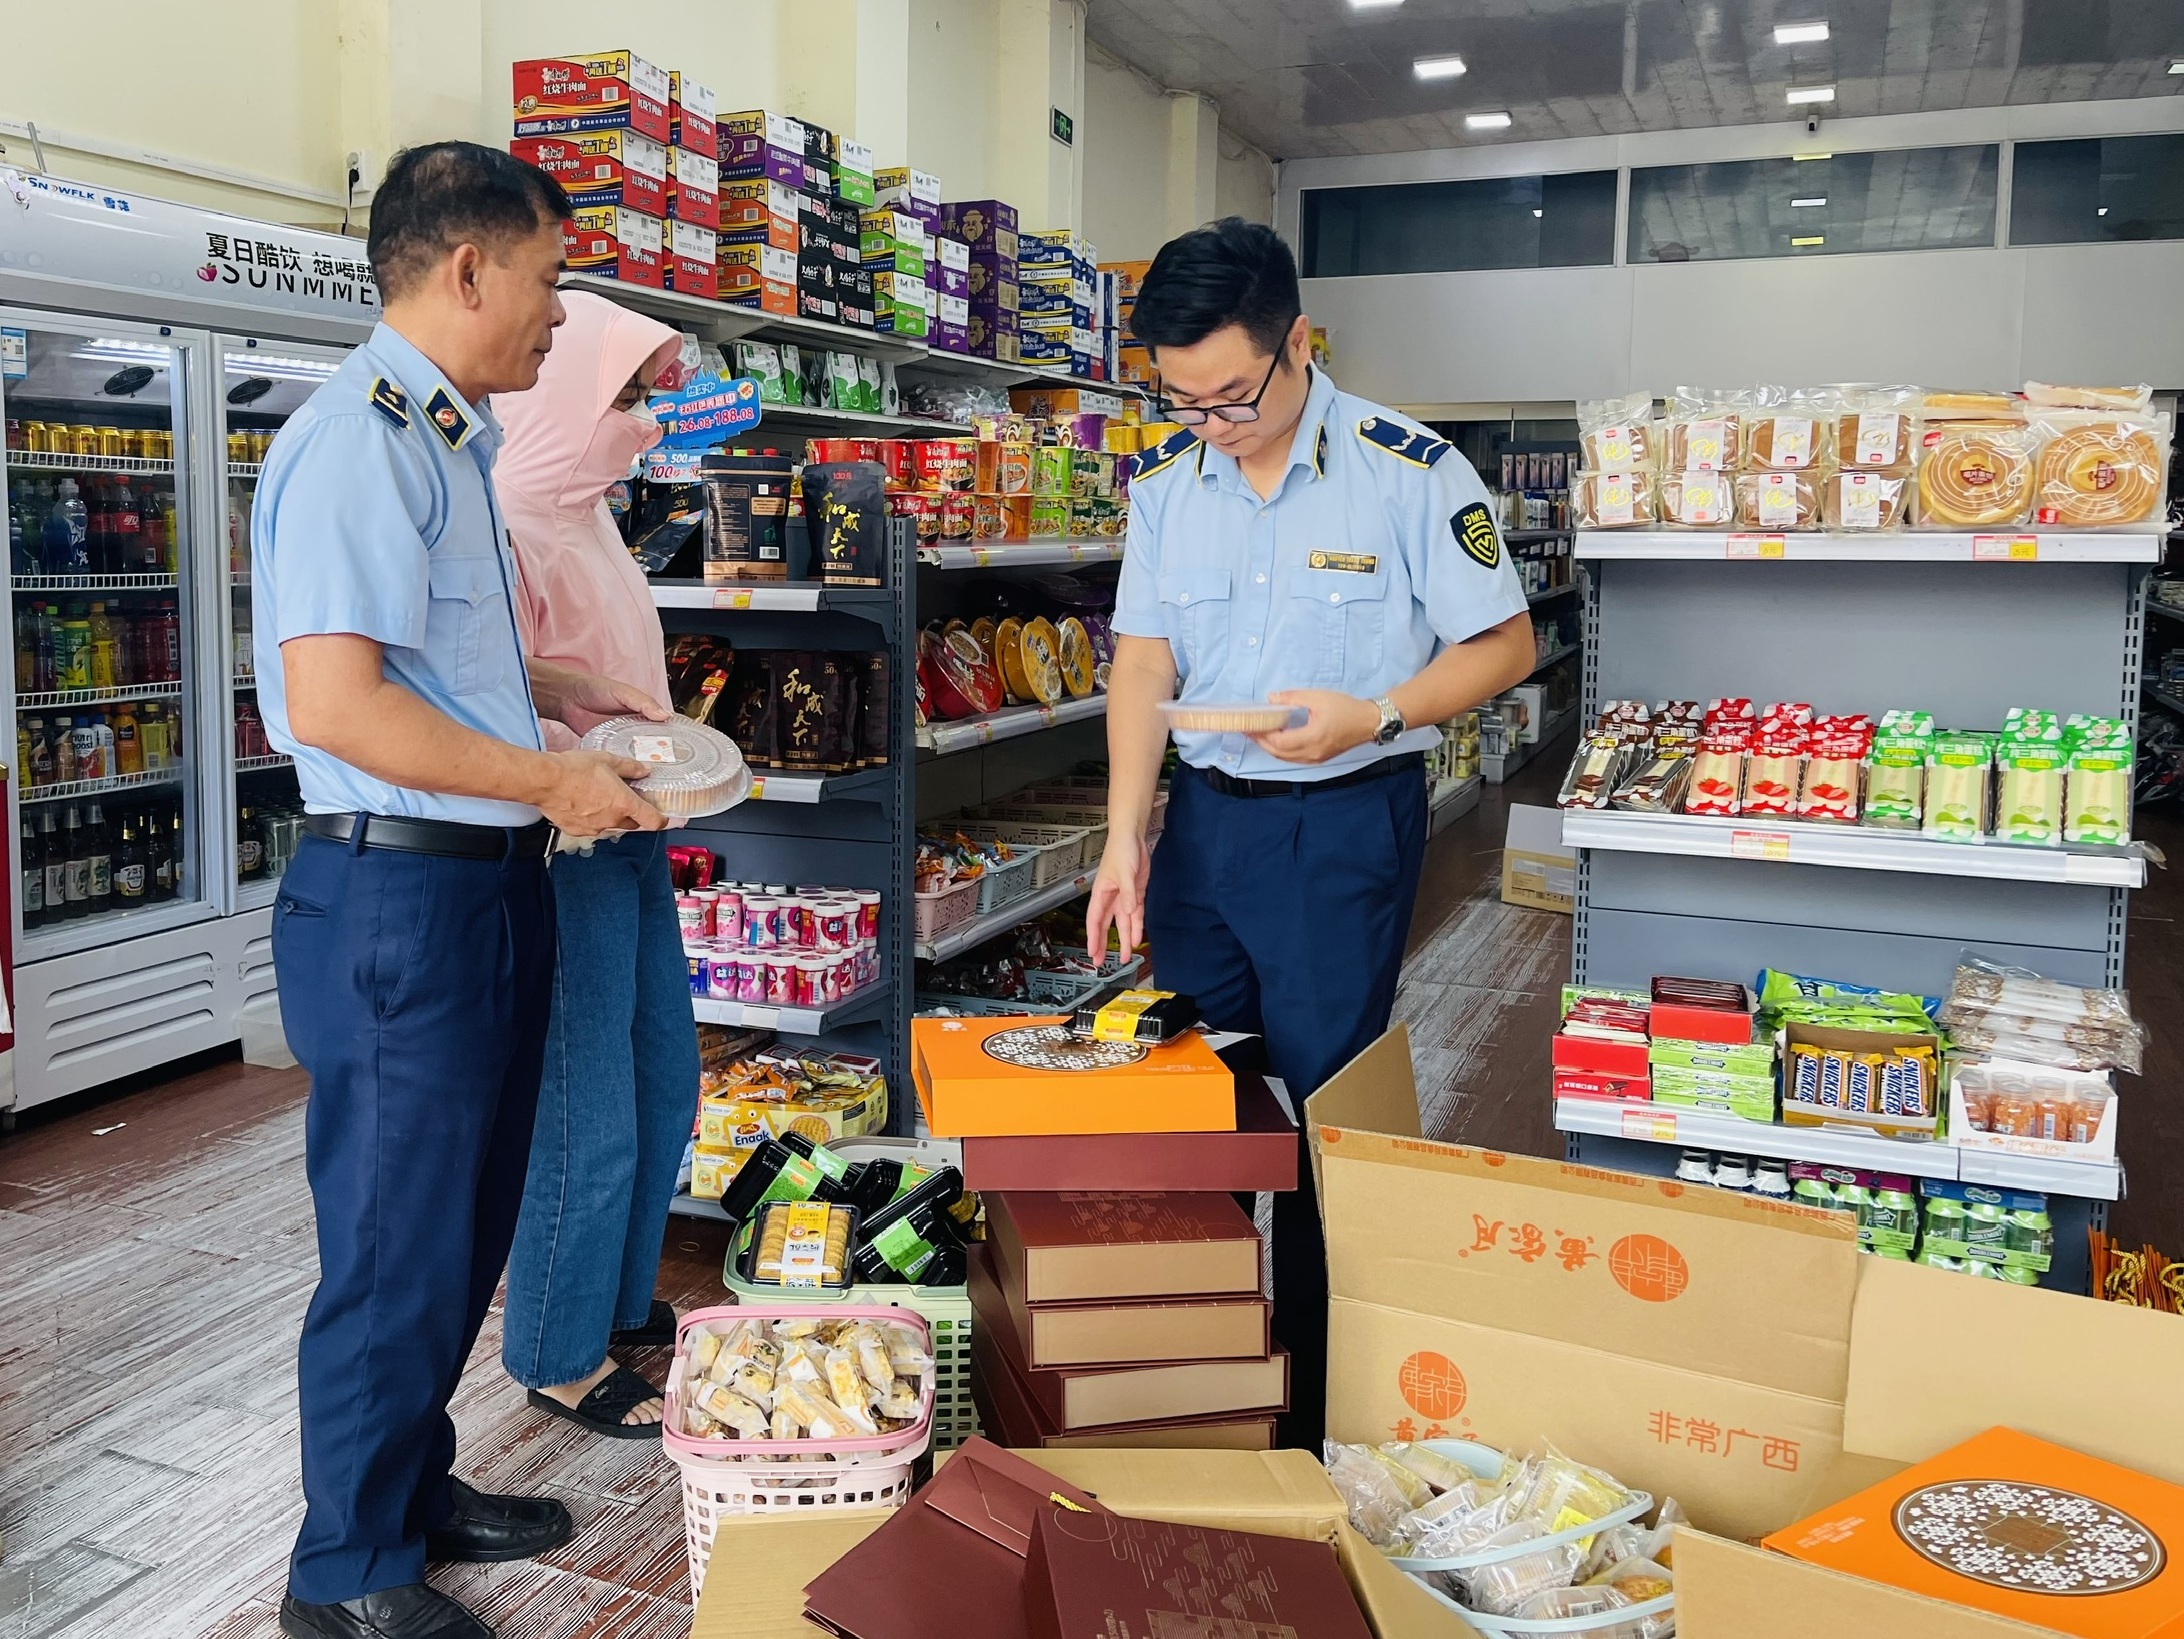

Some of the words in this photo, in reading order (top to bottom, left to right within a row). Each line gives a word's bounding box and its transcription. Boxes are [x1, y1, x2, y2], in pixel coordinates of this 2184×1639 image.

[206, 231, 302, 273] 夏日酷饮
[678, 407, 754, 434] 26.08-188.08
[1462, 508, 1487, 527] DMS
[1800, 1054, 1819, 1104] SNICKERS
[1822, 1055, 1842, 1108] SNICKERS
[1850, 1062, 1870, 1113] SNICKERS
[1885, 1065, 1902, 1116] SNICKERS
[1904, 1058, 1921, 1114] SNICKERS
[735, 1130, 771, 1146] Enaak
[1470, 1213, 1600, 1271] 黄家月
[1647, 1409, 1802, 1474] 非常广西
